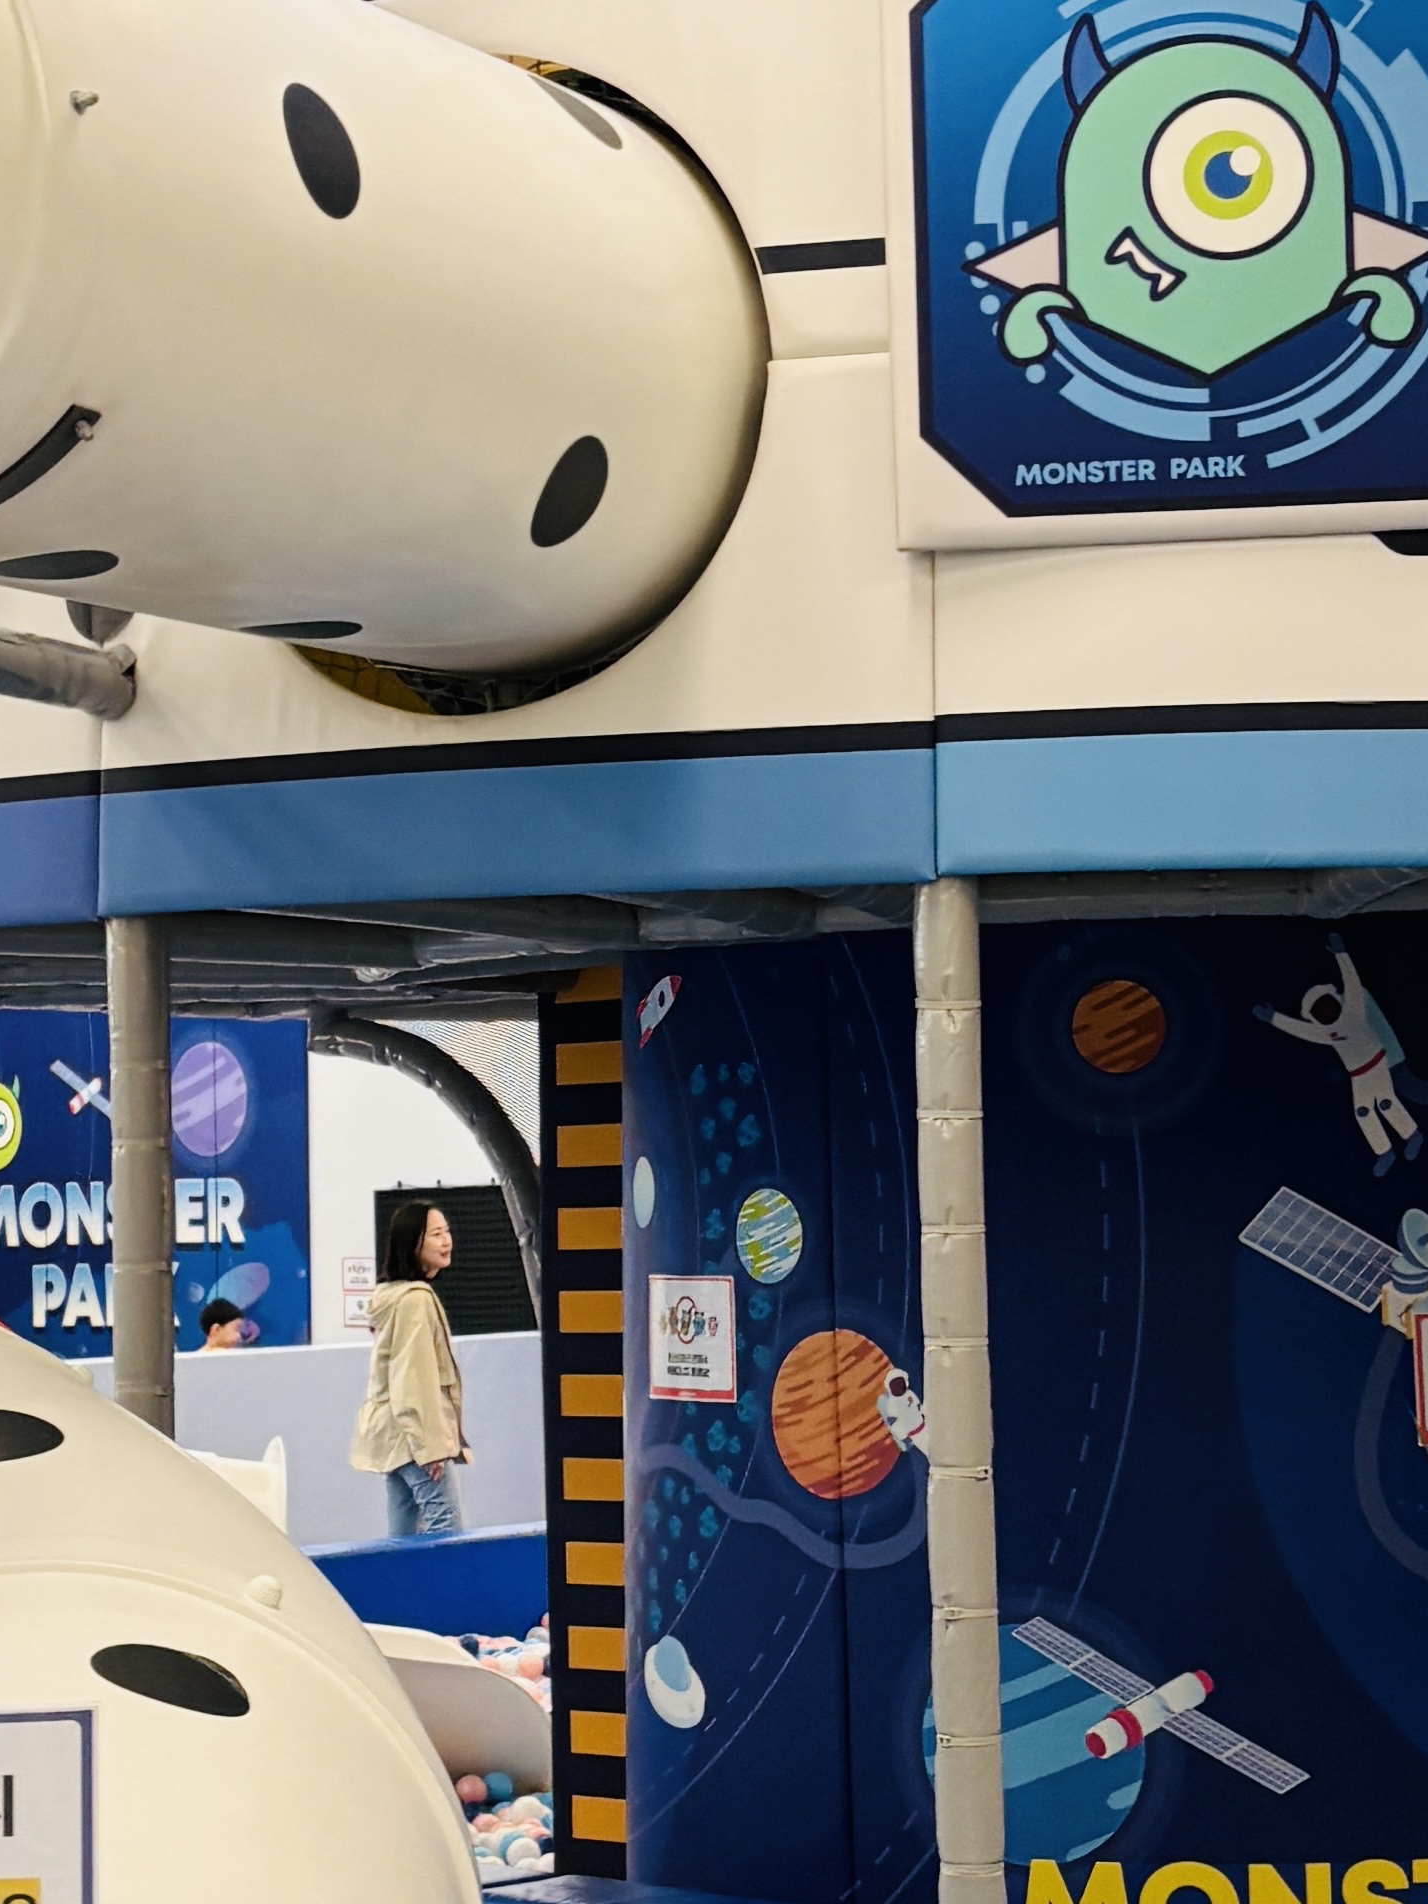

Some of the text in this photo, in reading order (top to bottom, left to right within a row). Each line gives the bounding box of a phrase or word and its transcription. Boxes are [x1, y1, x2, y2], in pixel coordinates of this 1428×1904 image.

[1015, 454, 1246, 486] MONSTER PARK
[32, 1262, 180, 1328] PA
